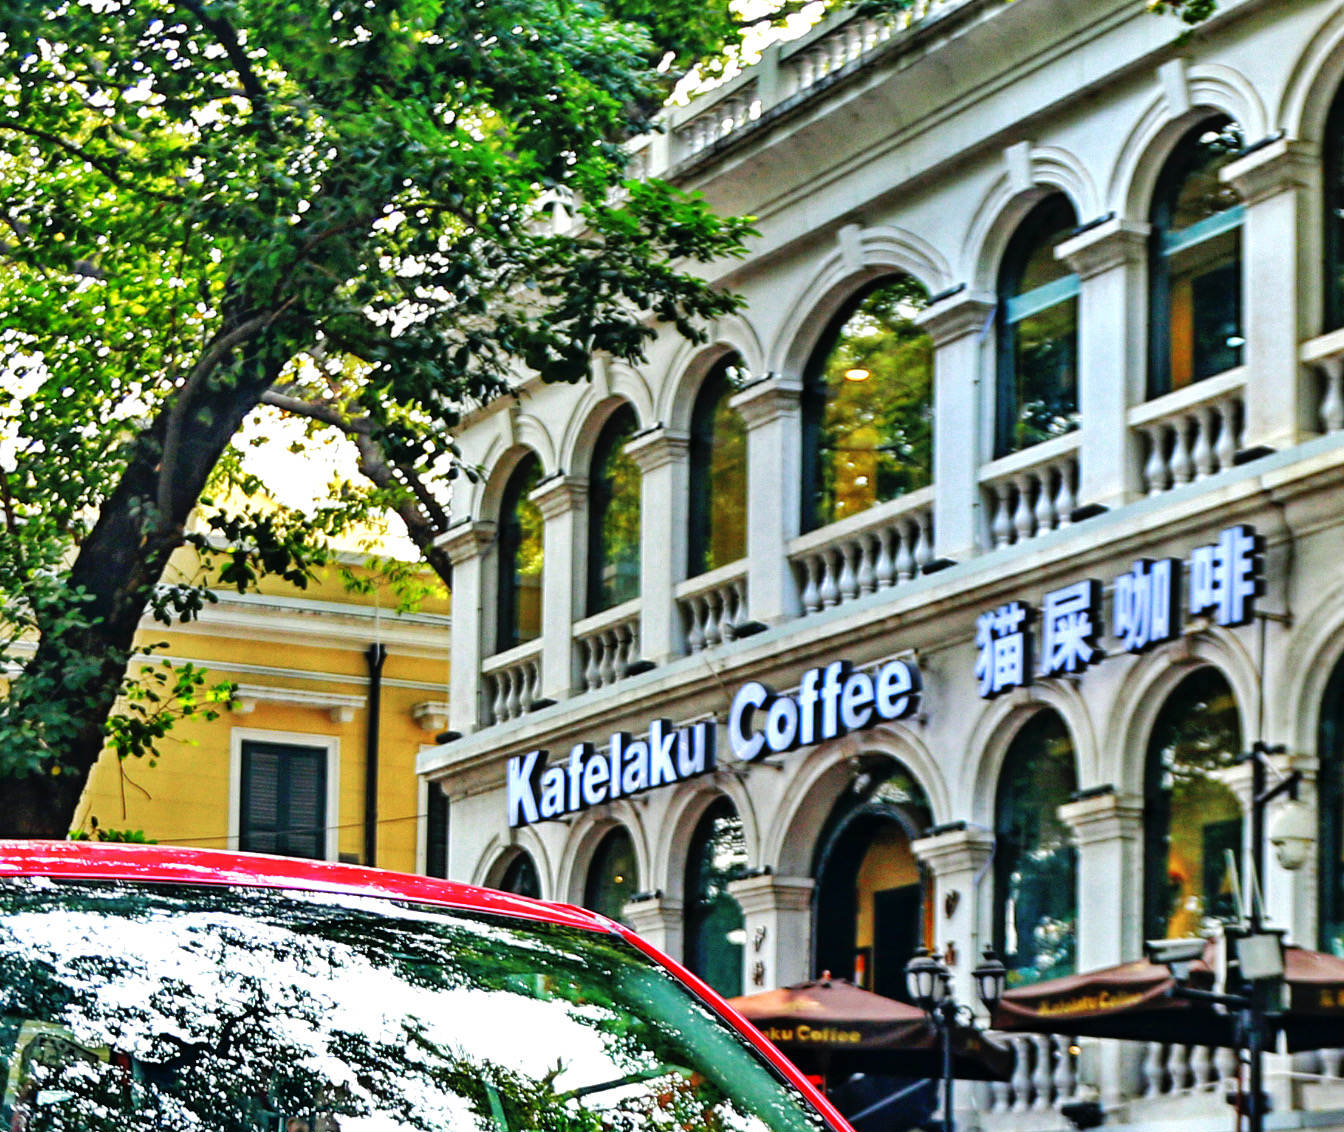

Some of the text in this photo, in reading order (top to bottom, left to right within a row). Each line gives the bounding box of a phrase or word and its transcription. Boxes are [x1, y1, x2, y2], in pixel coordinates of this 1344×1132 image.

[975, 525, 1256, 698] 猫屎咖啡
[507, 660, 916, 827] Kafelaku Coffee
